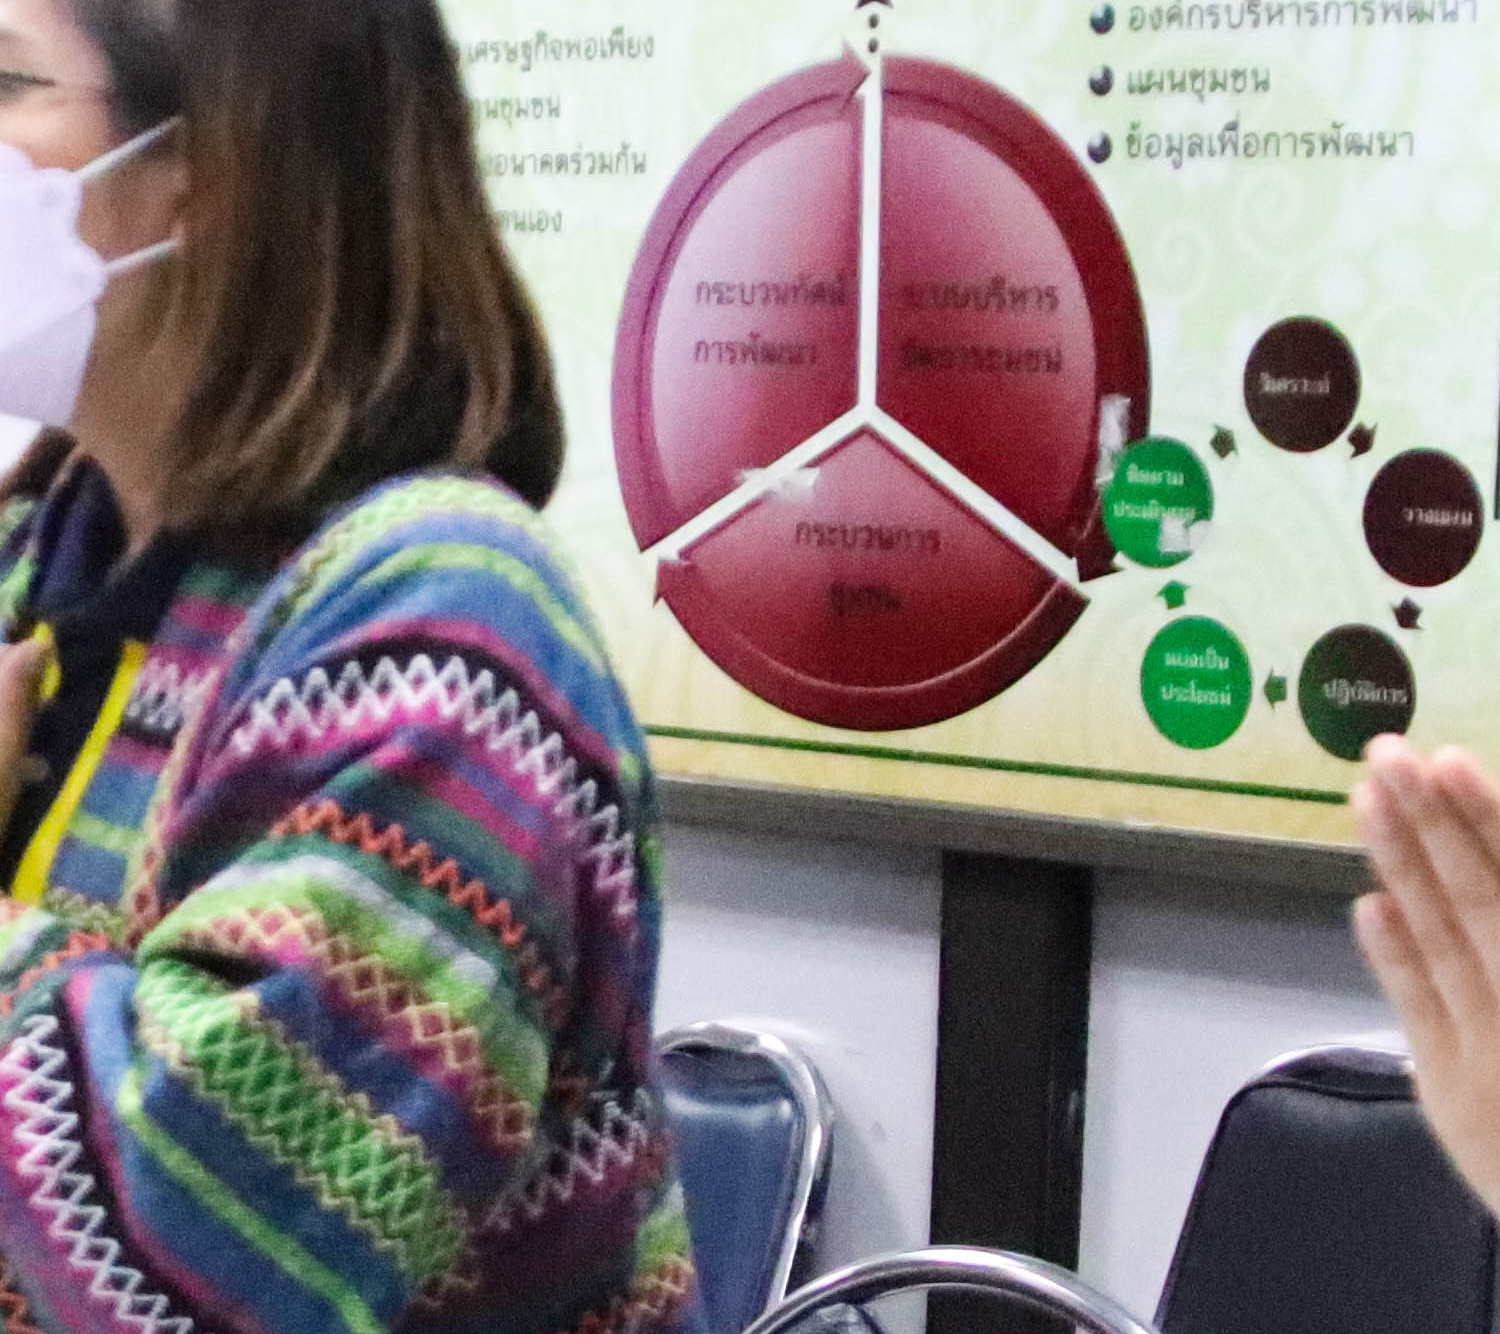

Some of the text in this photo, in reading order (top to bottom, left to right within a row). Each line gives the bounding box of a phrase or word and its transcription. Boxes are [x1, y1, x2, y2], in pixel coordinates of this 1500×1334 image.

[1126, 67, 1272, 103] แผนชุมชน
[1125, 110, 1416, 170] ข้อมูลเพื่อการพัฒนา
